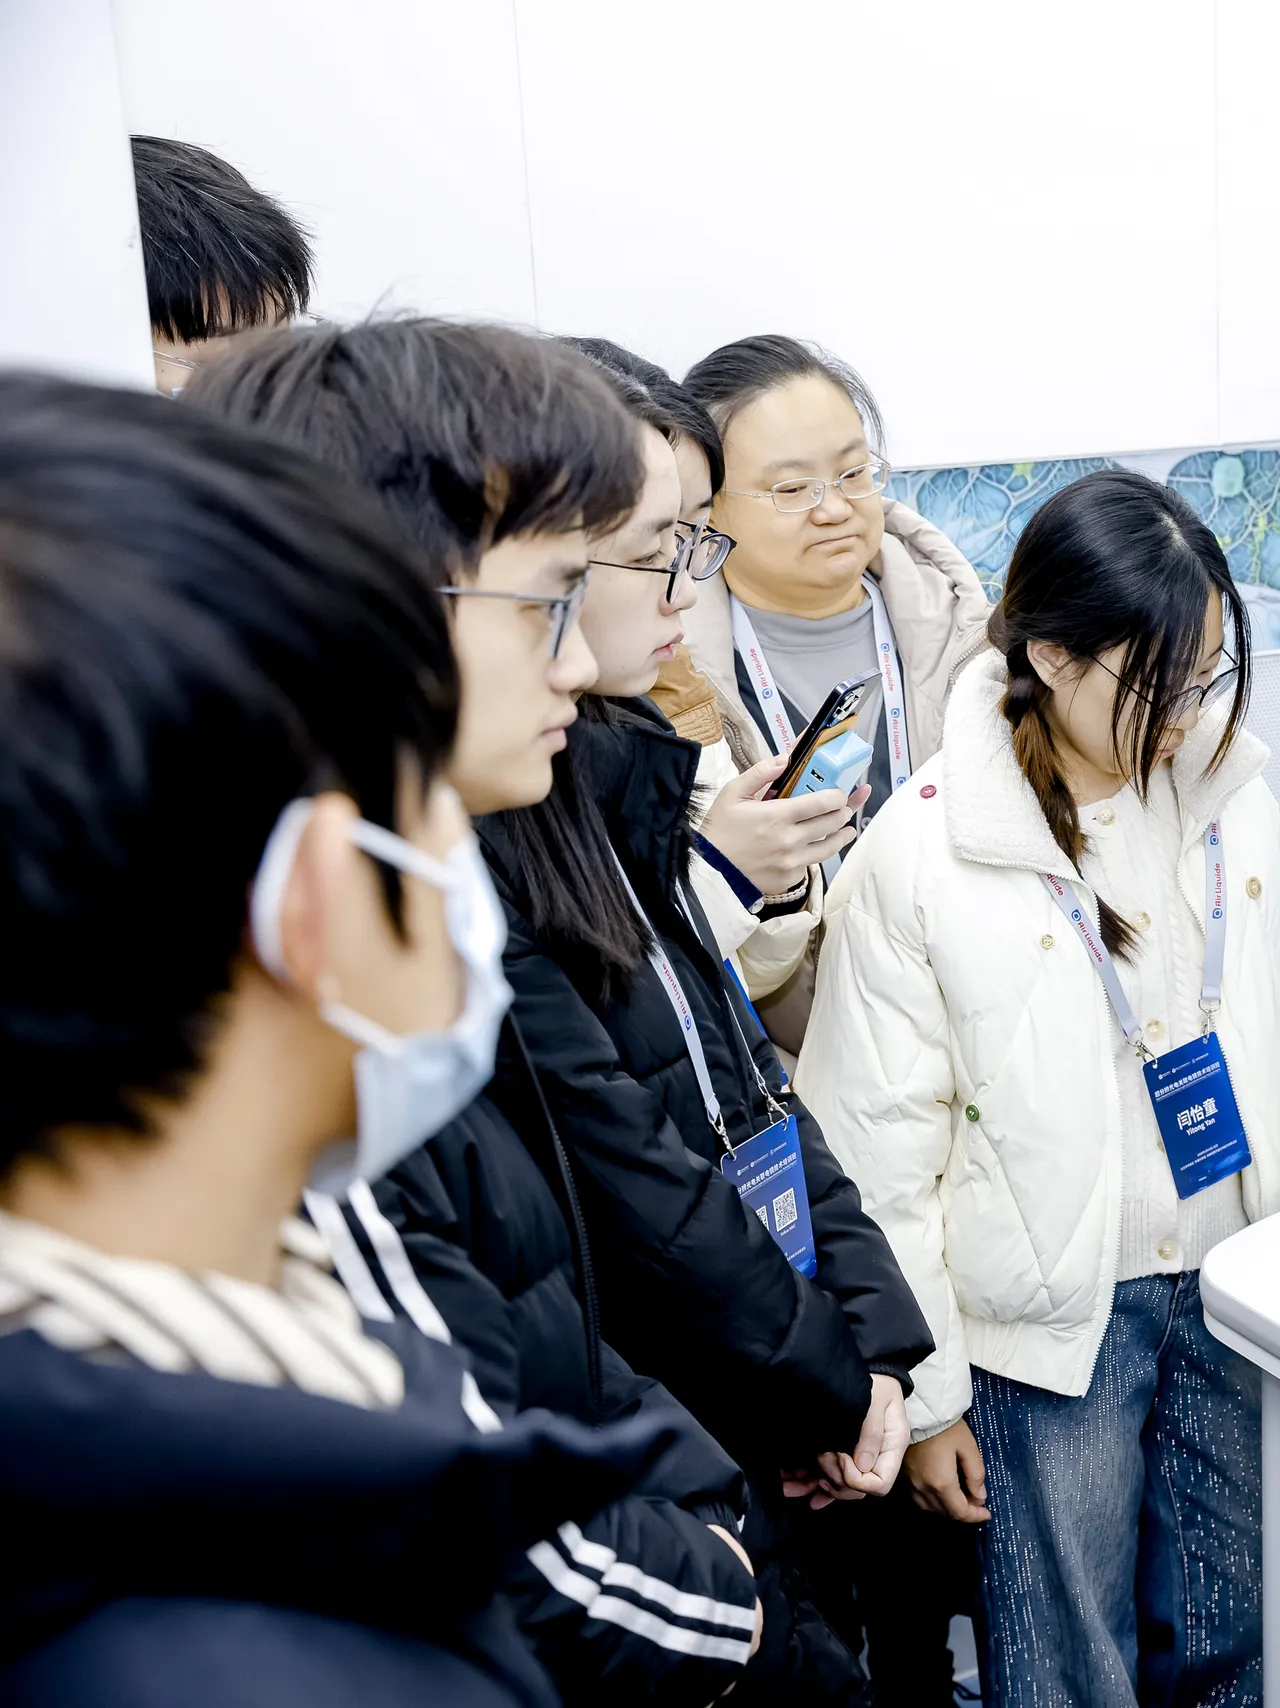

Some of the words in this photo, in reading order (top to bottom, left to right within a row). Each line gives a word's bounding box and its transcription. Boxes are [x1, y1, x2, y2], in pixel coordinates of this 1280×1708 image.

[750, 648, 764, 675] Liquide
[885, 663, 895, 692] Liquide
[892, 729, 902, 760] Liquide
[1046, 873, 1064, 896] quide
[1077, 921, 1088, 933] Air
[1084, 933, 1103, 963] Liquide
[662, 963, 681, 1000] Liquide
[1177, 1097, 1219, 1130] 闫怡童
[1186, 1123, 1206, 1136] Yitong
[1204, 1118, 1216, 1127] Yan
[737, 1152, 797, 1195] 分辨光电关联电镜技术培训班
